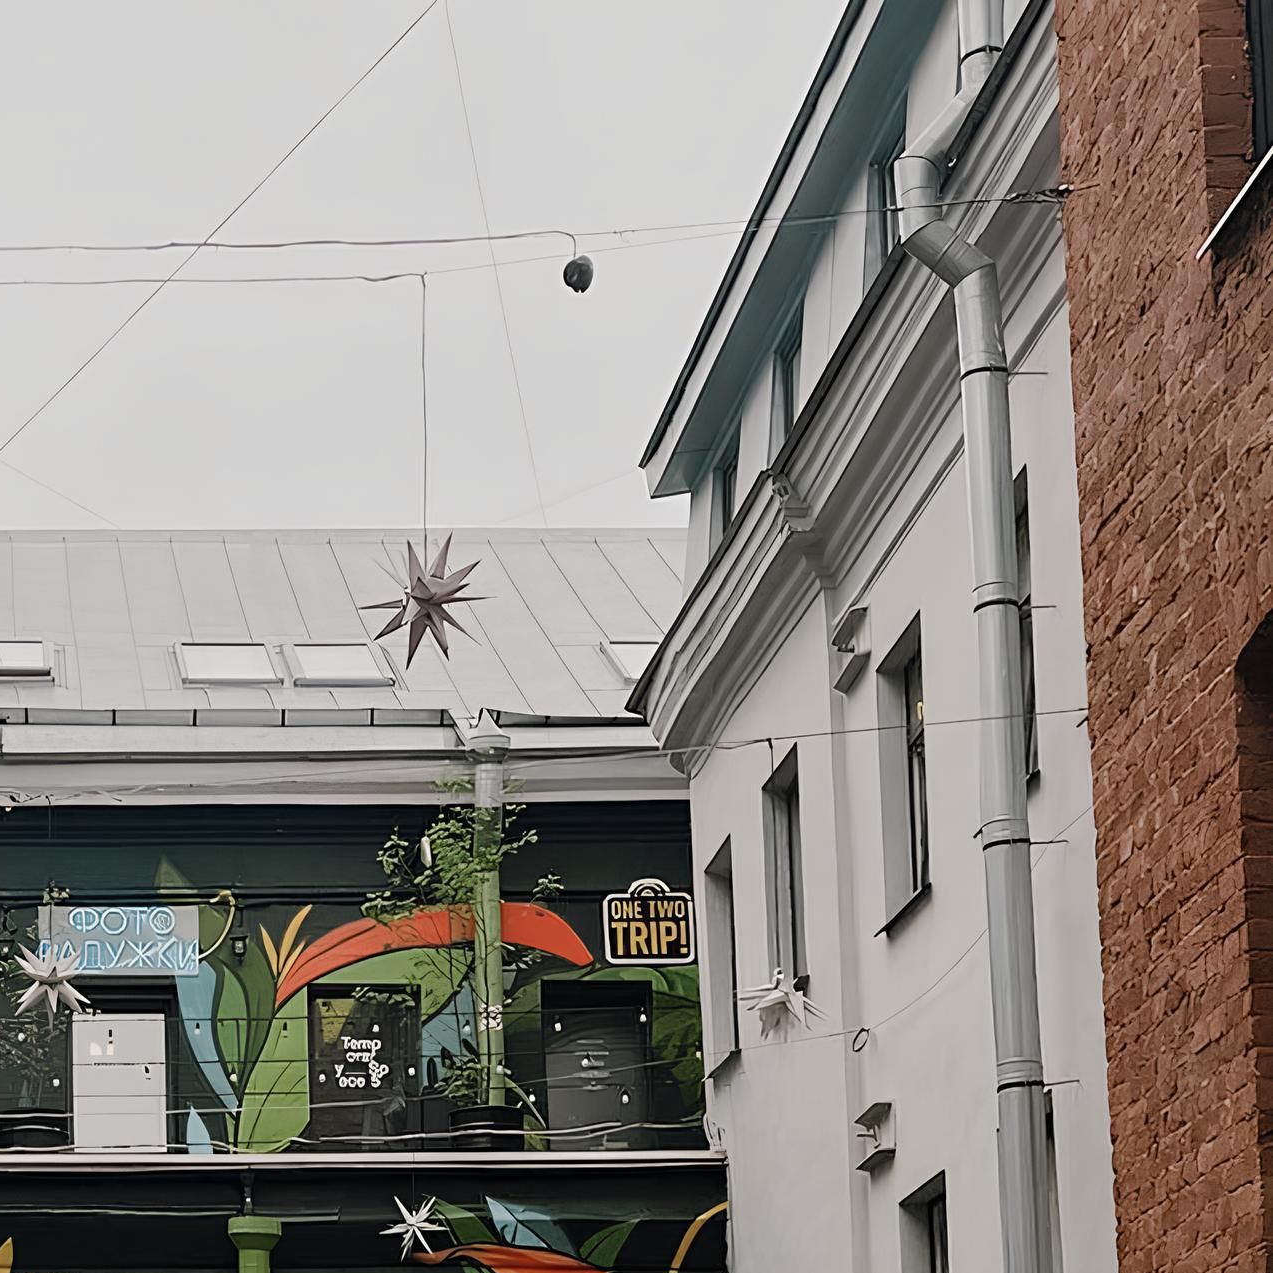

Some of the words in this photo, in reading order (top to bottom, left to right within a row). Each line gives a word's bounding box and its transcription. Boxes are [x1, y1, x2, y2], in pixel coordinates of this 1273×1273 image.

[68, 906, 176, 934] ФОТО
[611, 901, 643, 919] ONE
[647, 900, 685, 918] TWO
[611, 920, 688, 956] TRIP!
